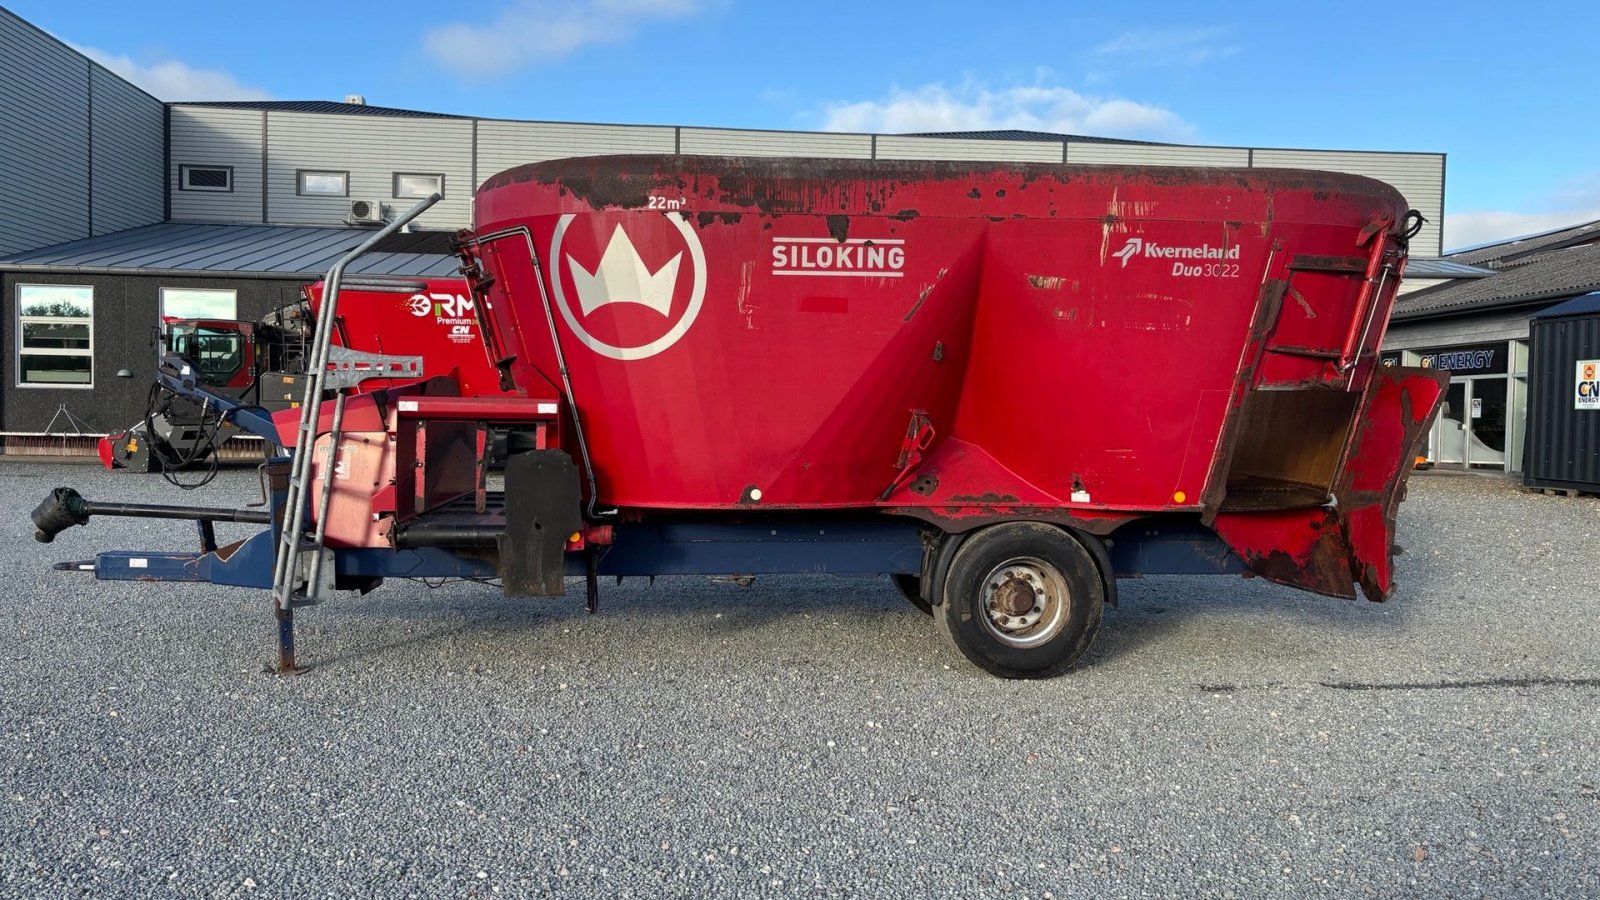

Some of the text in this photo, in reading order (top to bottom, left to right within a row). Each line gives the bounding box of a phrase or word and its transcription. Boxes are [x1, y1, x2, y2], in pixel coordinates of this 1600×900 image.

[772, 245, 905, 269] SILOKING
[1144, 242, 1240, 259] Kverneland
[1171, 262, 1240, 278] Duo 3022
[1438, 350, 1495, 370] ENERGY
[1578, 381, 1600, 397] CN
